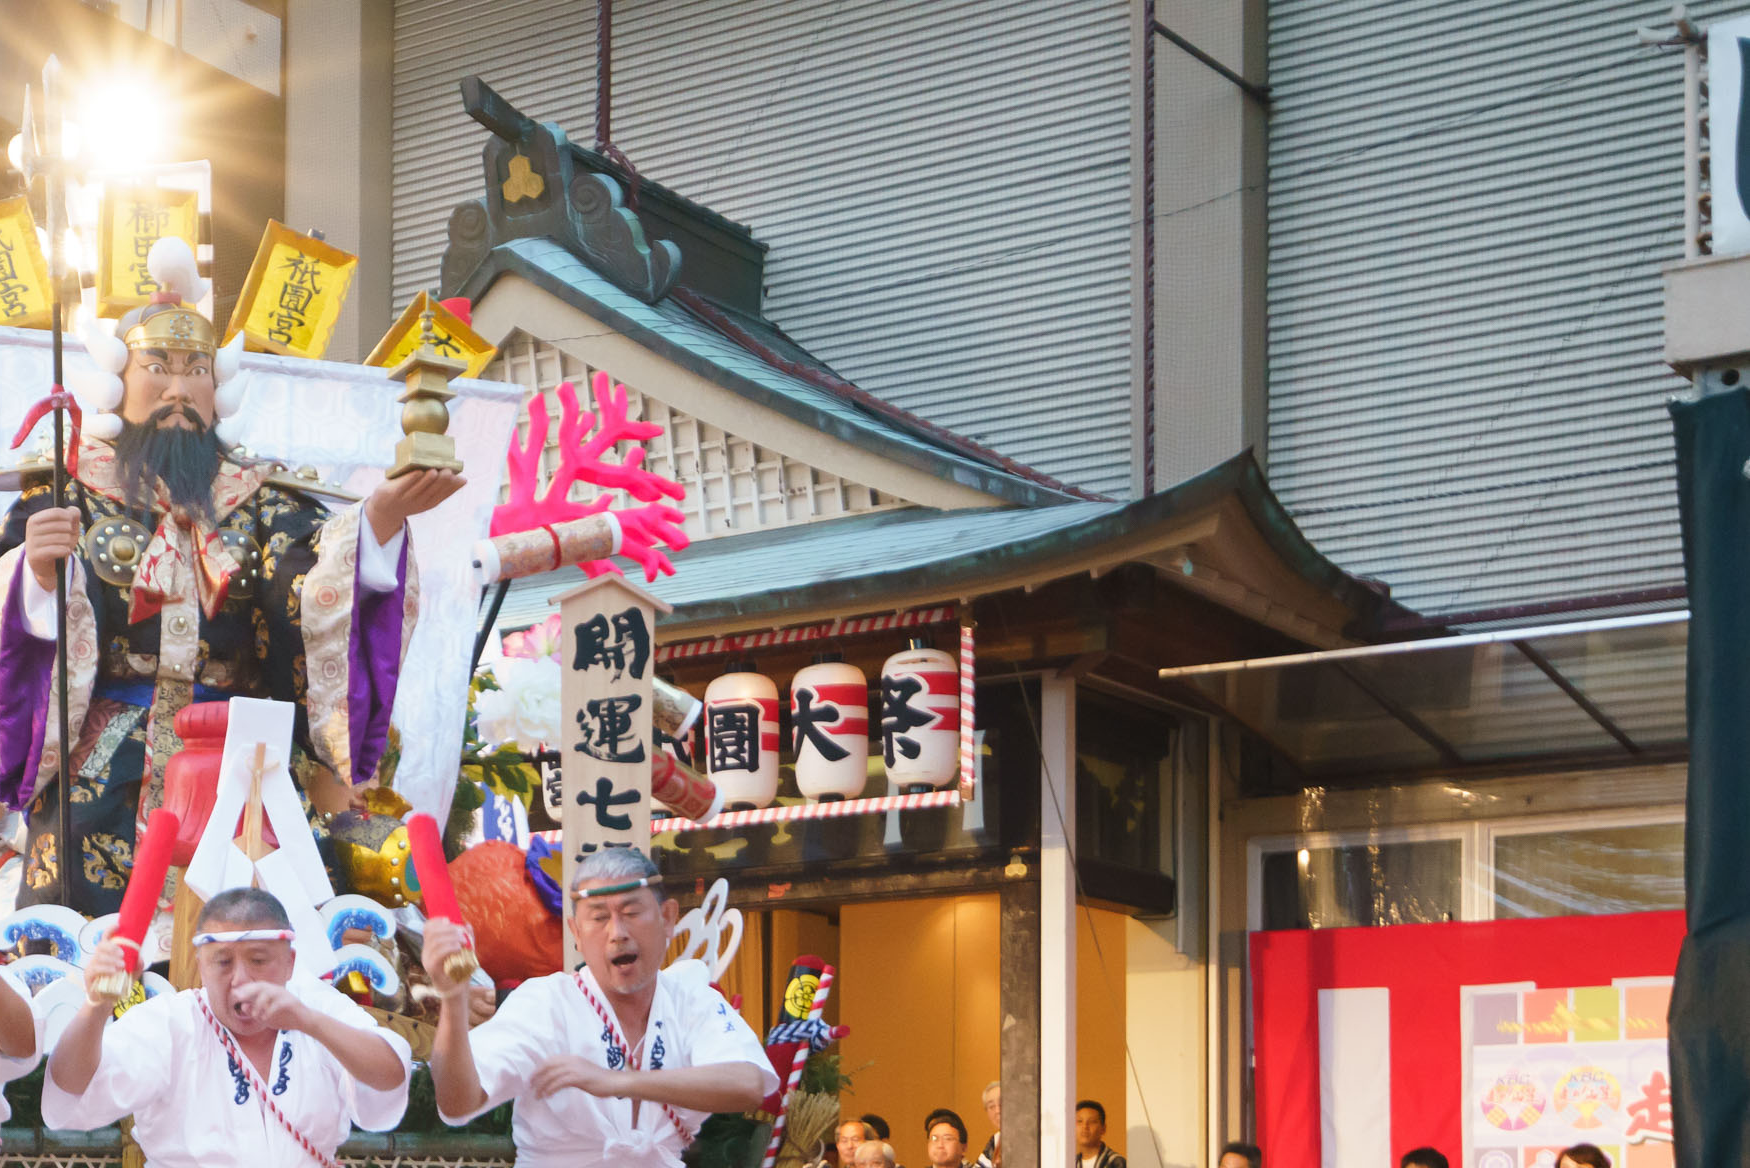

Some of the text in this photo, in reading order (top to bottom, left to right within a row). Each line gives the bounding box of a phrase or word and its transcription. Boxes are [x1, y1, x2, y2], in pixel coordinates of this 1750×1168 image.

[268, 250, 322, 346] 祇園宮
[572, 606, 650, 862] 開運七
